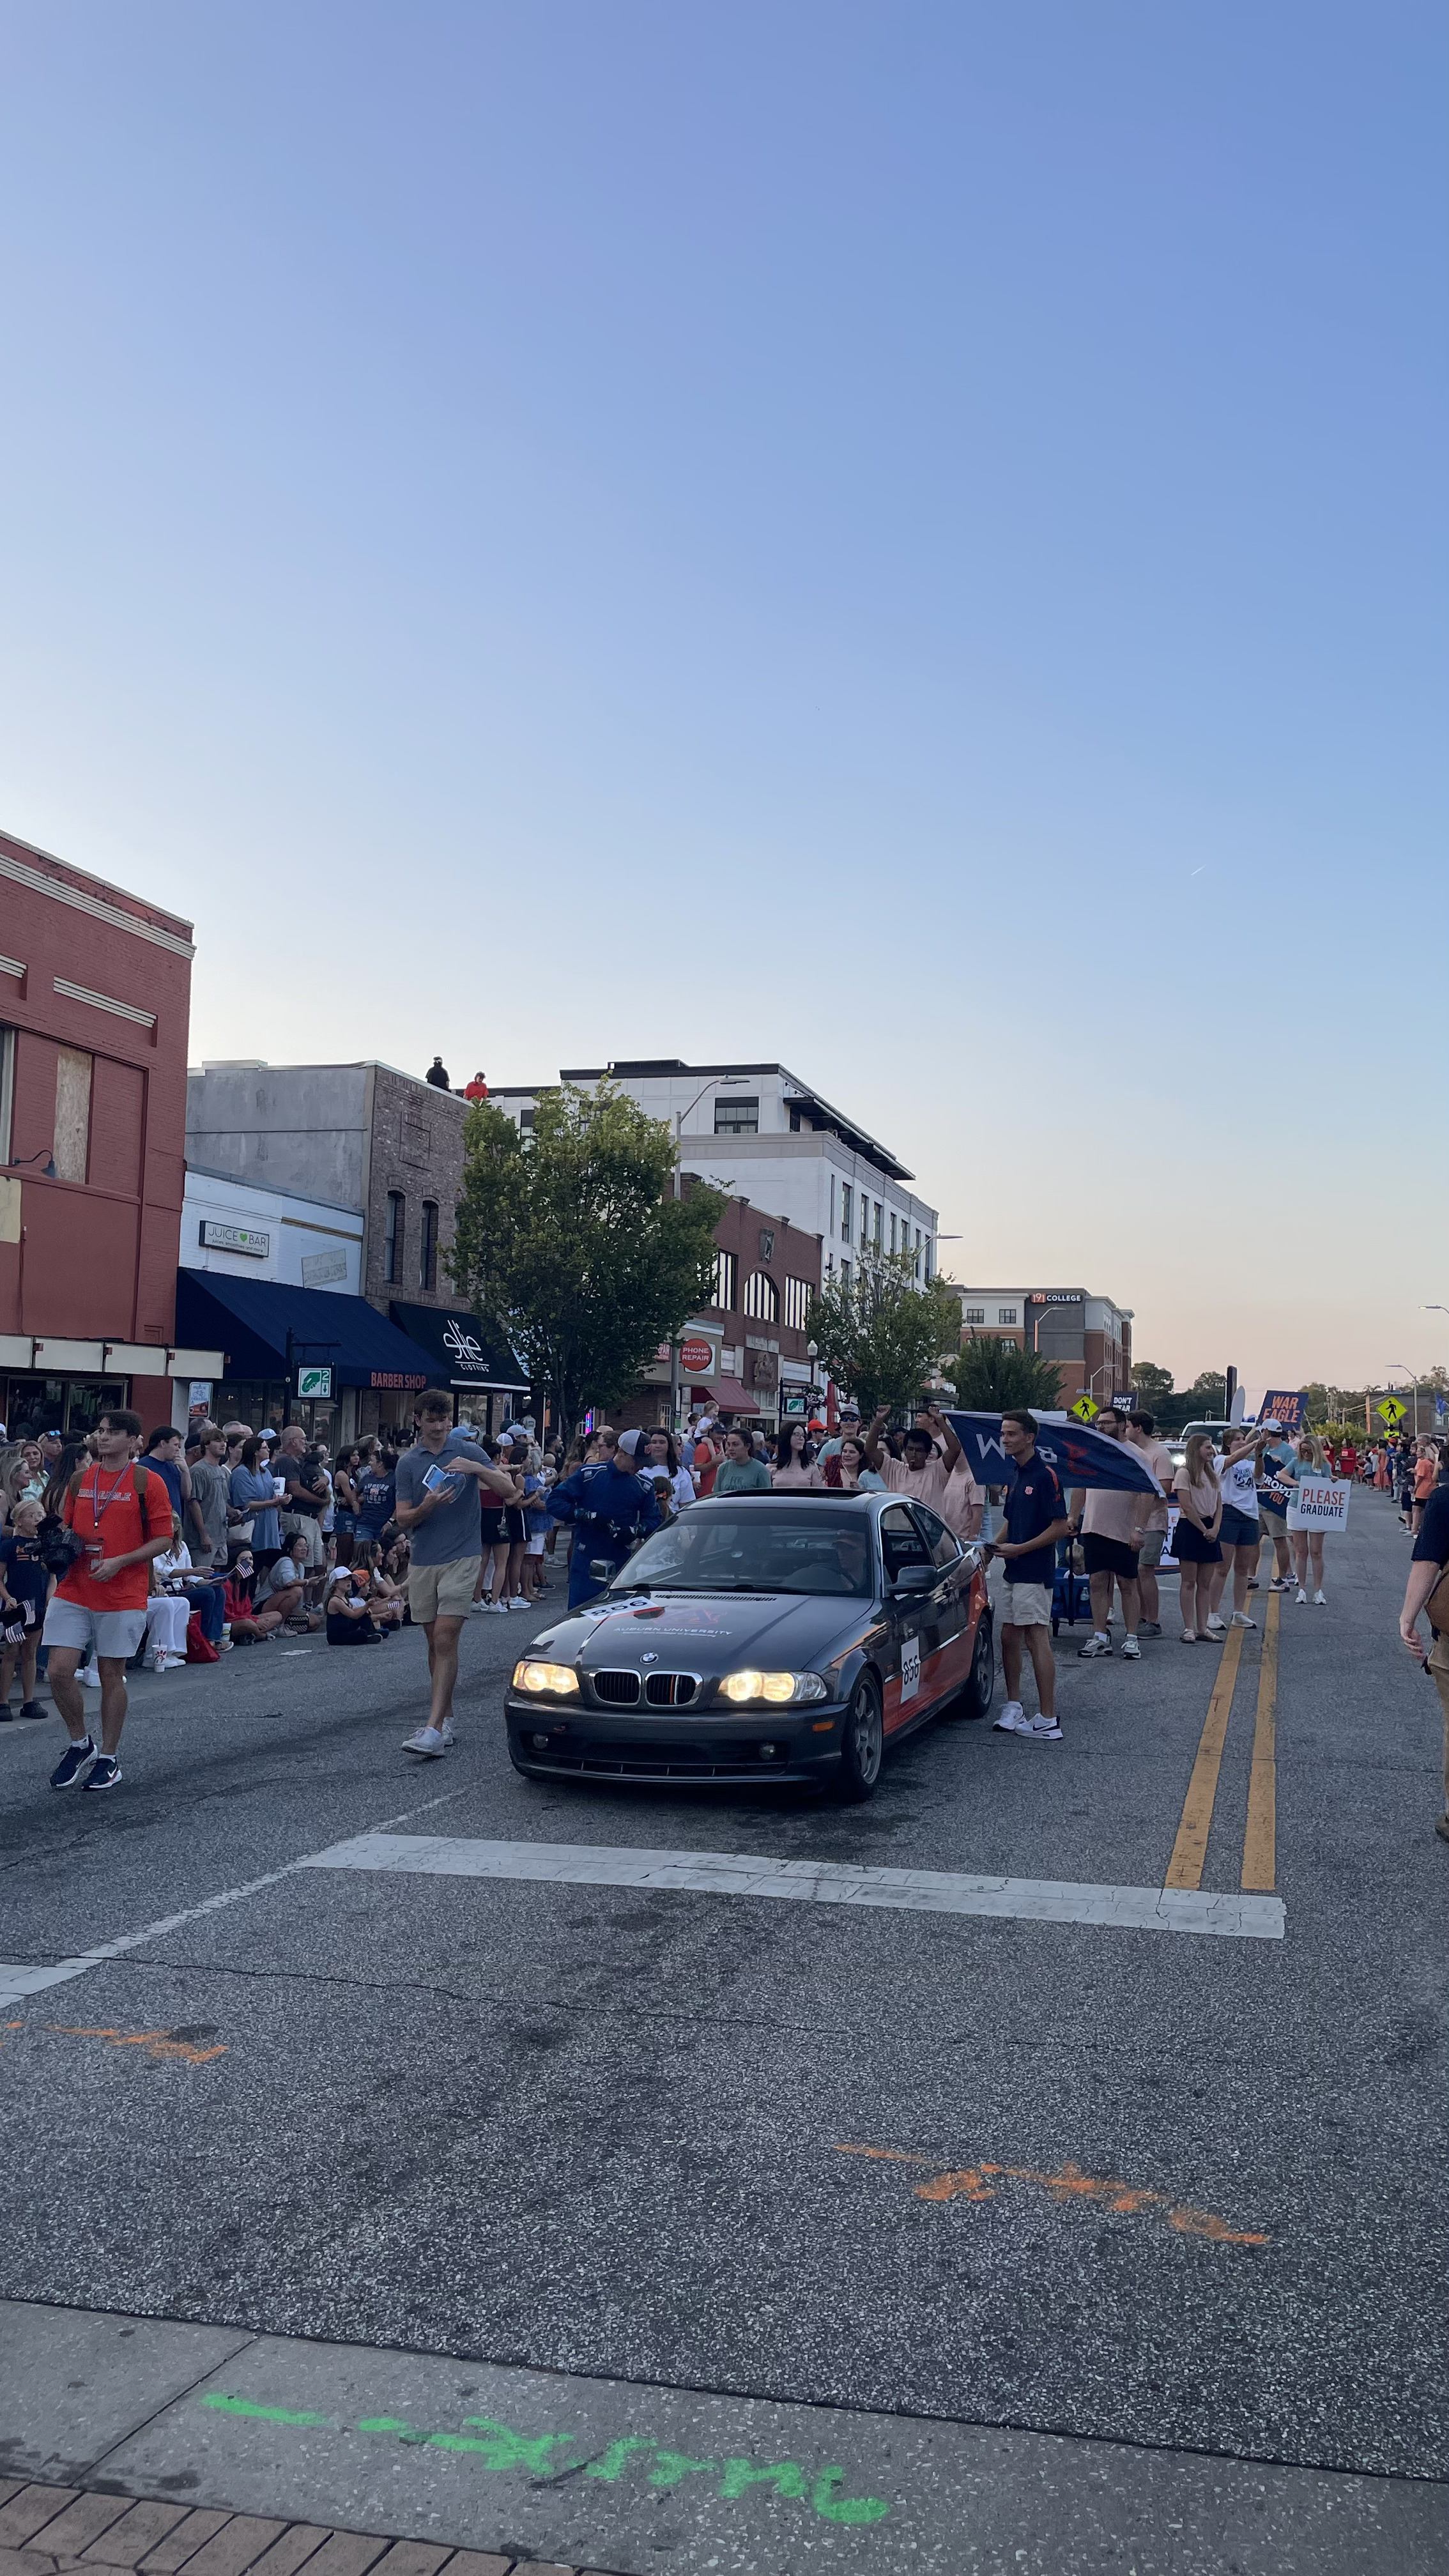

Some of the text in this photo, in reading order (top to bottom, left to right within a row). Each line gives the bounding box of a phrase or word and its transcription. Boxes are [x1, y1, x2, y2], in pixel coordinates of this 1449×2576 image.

[208, 1227, 266, 1246] JUICE BAR
[1032, 1292, 1045, 1303] 191
[321, 1370, 330, 1381] 2
[371, 1372, 426, 1389] BARBER SHOP
[1271, 1396, 1299, 1409] WAR
[1262, 1408, 1300, 1423] EAGLE
[1268, 1492, 1285, 1505] YOU
[1302, 1489, 1346, 1506] PLEASE
[1301, 1503, 1344, 1518] GRADUATE
[663, 1627, 733, 1636] UNIVERSITY
[903, 1655, 919, 1685] 856
